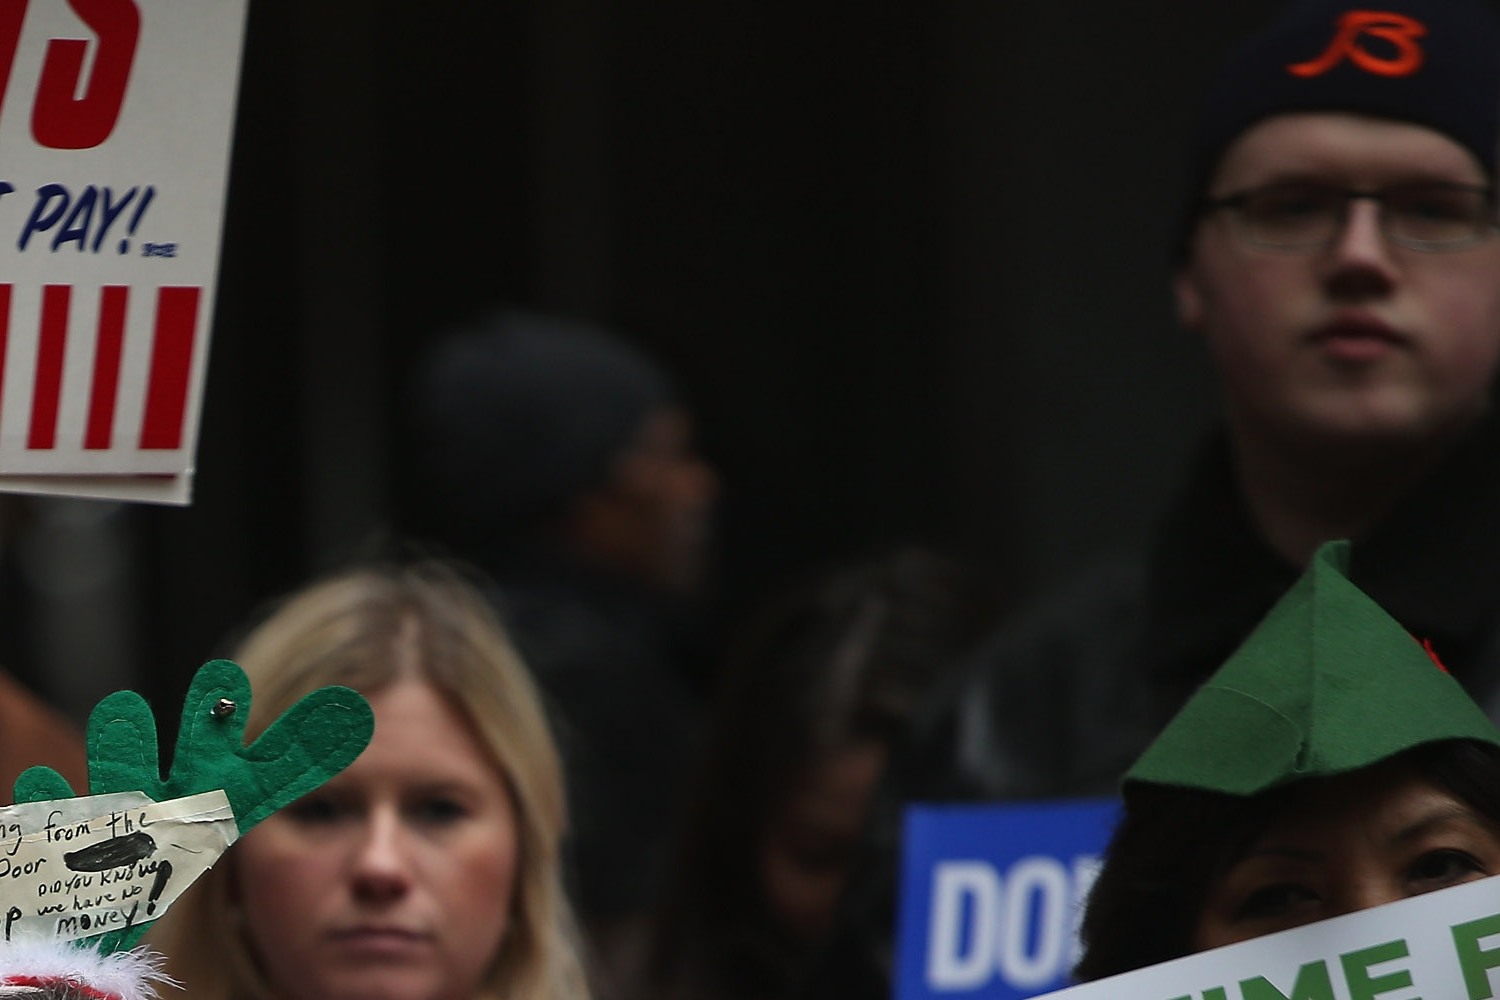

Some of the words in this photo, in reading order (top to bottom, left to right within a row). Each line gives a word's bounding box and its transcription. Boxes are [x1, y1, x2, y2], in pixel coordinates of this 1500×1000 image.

[18, 184, 156, 255] PAY!
[45, 810, 91, 843] from
[106, 810, 152, 838] the
[73, 894, 116, 911] have
